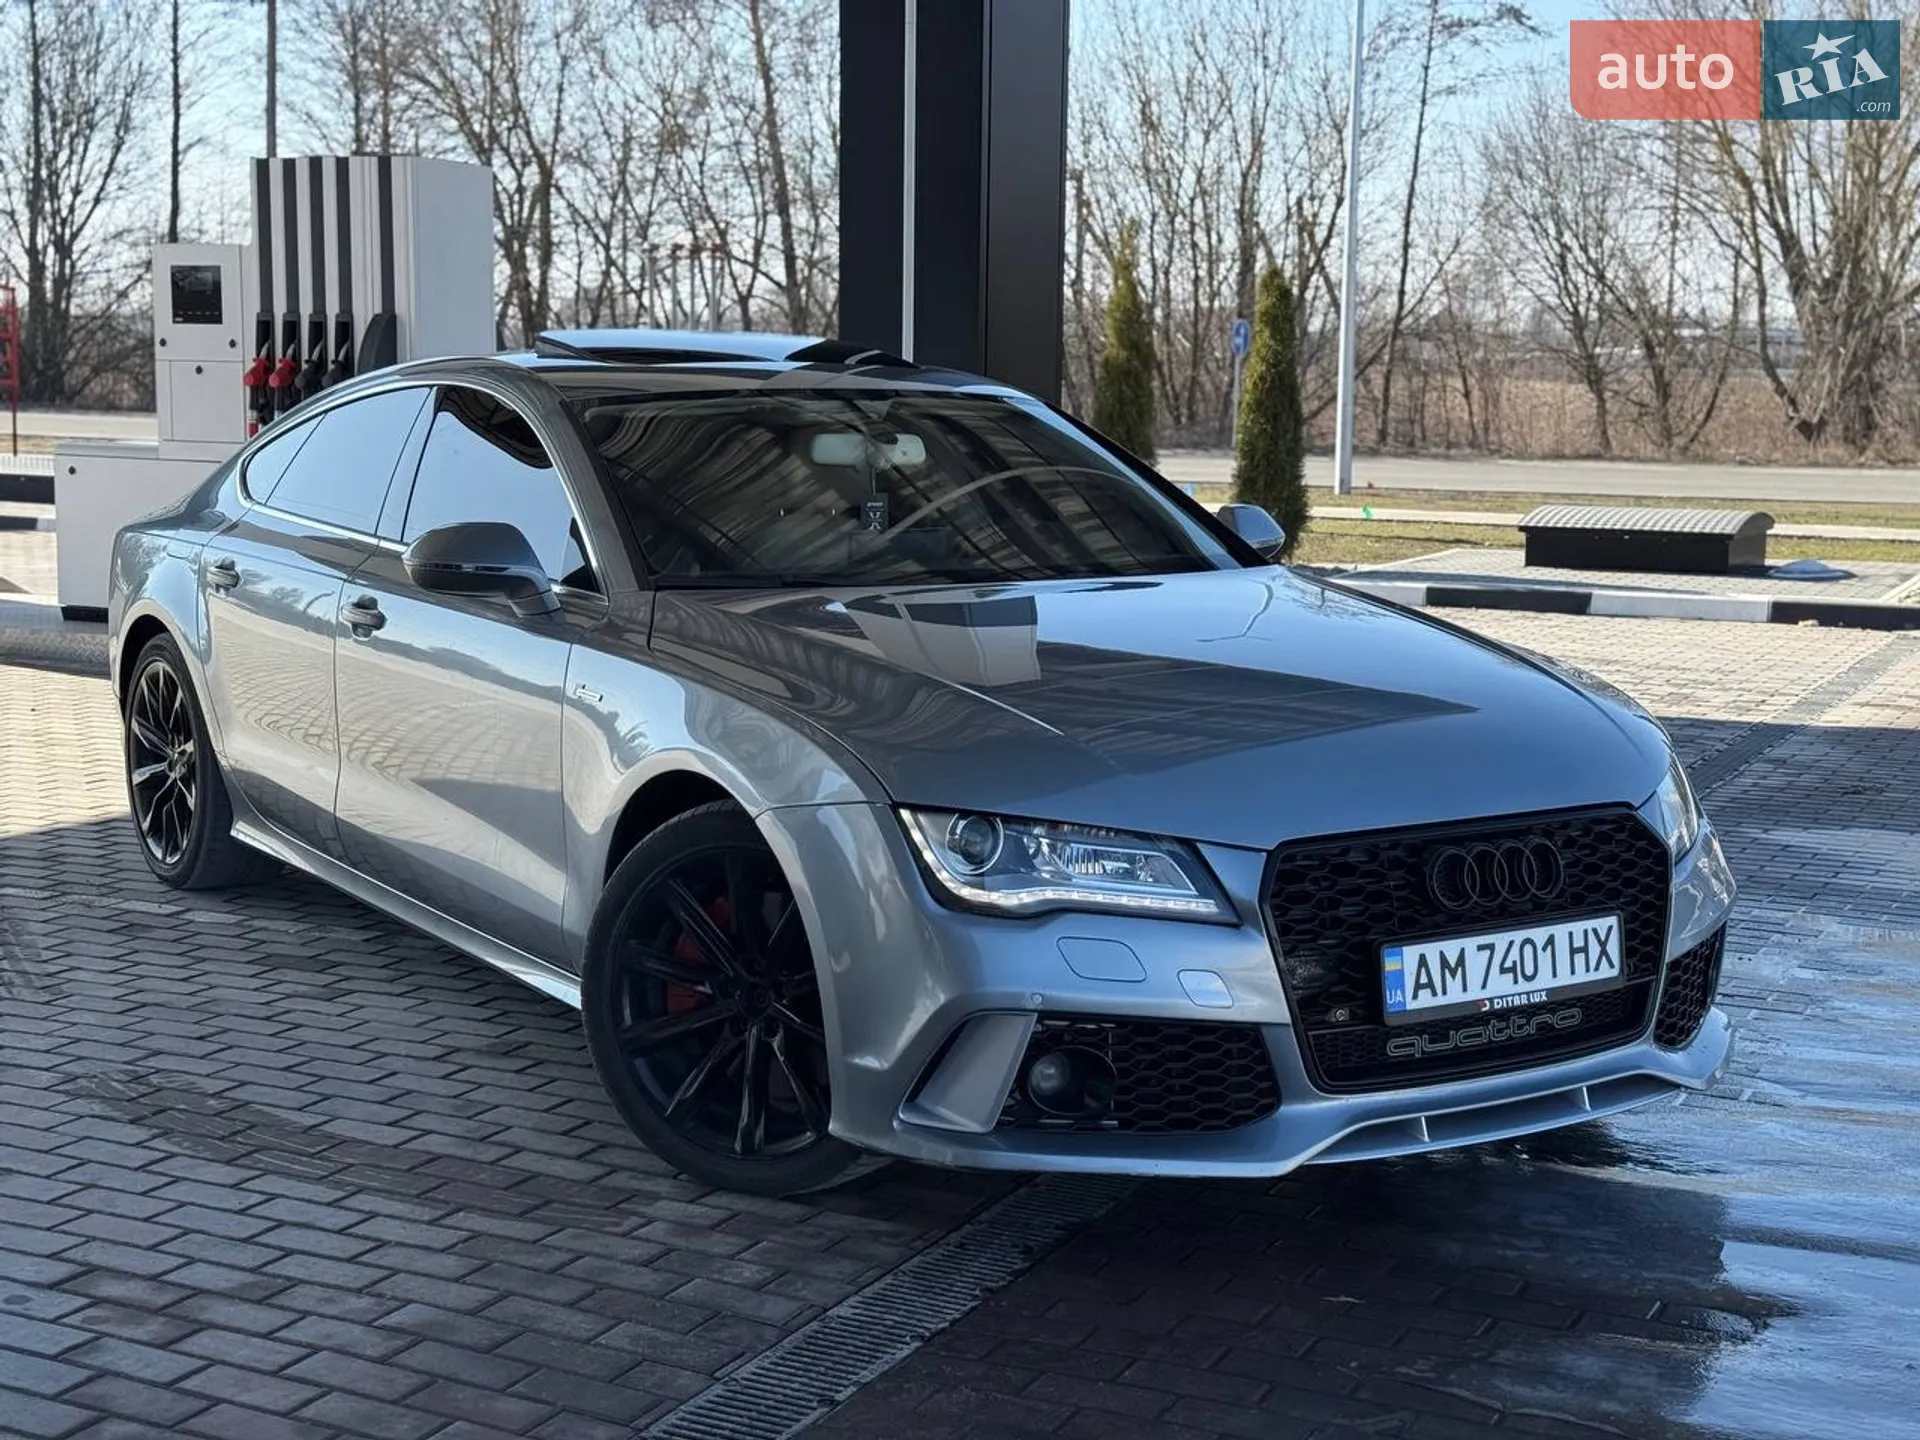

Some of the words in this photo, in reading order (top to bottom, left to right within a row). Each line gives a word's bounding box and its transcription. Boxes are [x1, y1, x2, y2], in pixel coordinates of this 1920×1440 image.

[1412, 946, 1468, 1001] AM
[1476, 933, 1557, 990] 7401
[1567, 924, 1615, 976] HX
[1385, 988, 1404, 1004] UA
[1493, 993, 1529, 1010] DITAR
[1529, 990, 1548, 1004] LUX
[1386, 1008, 1582, 1058] quattro
